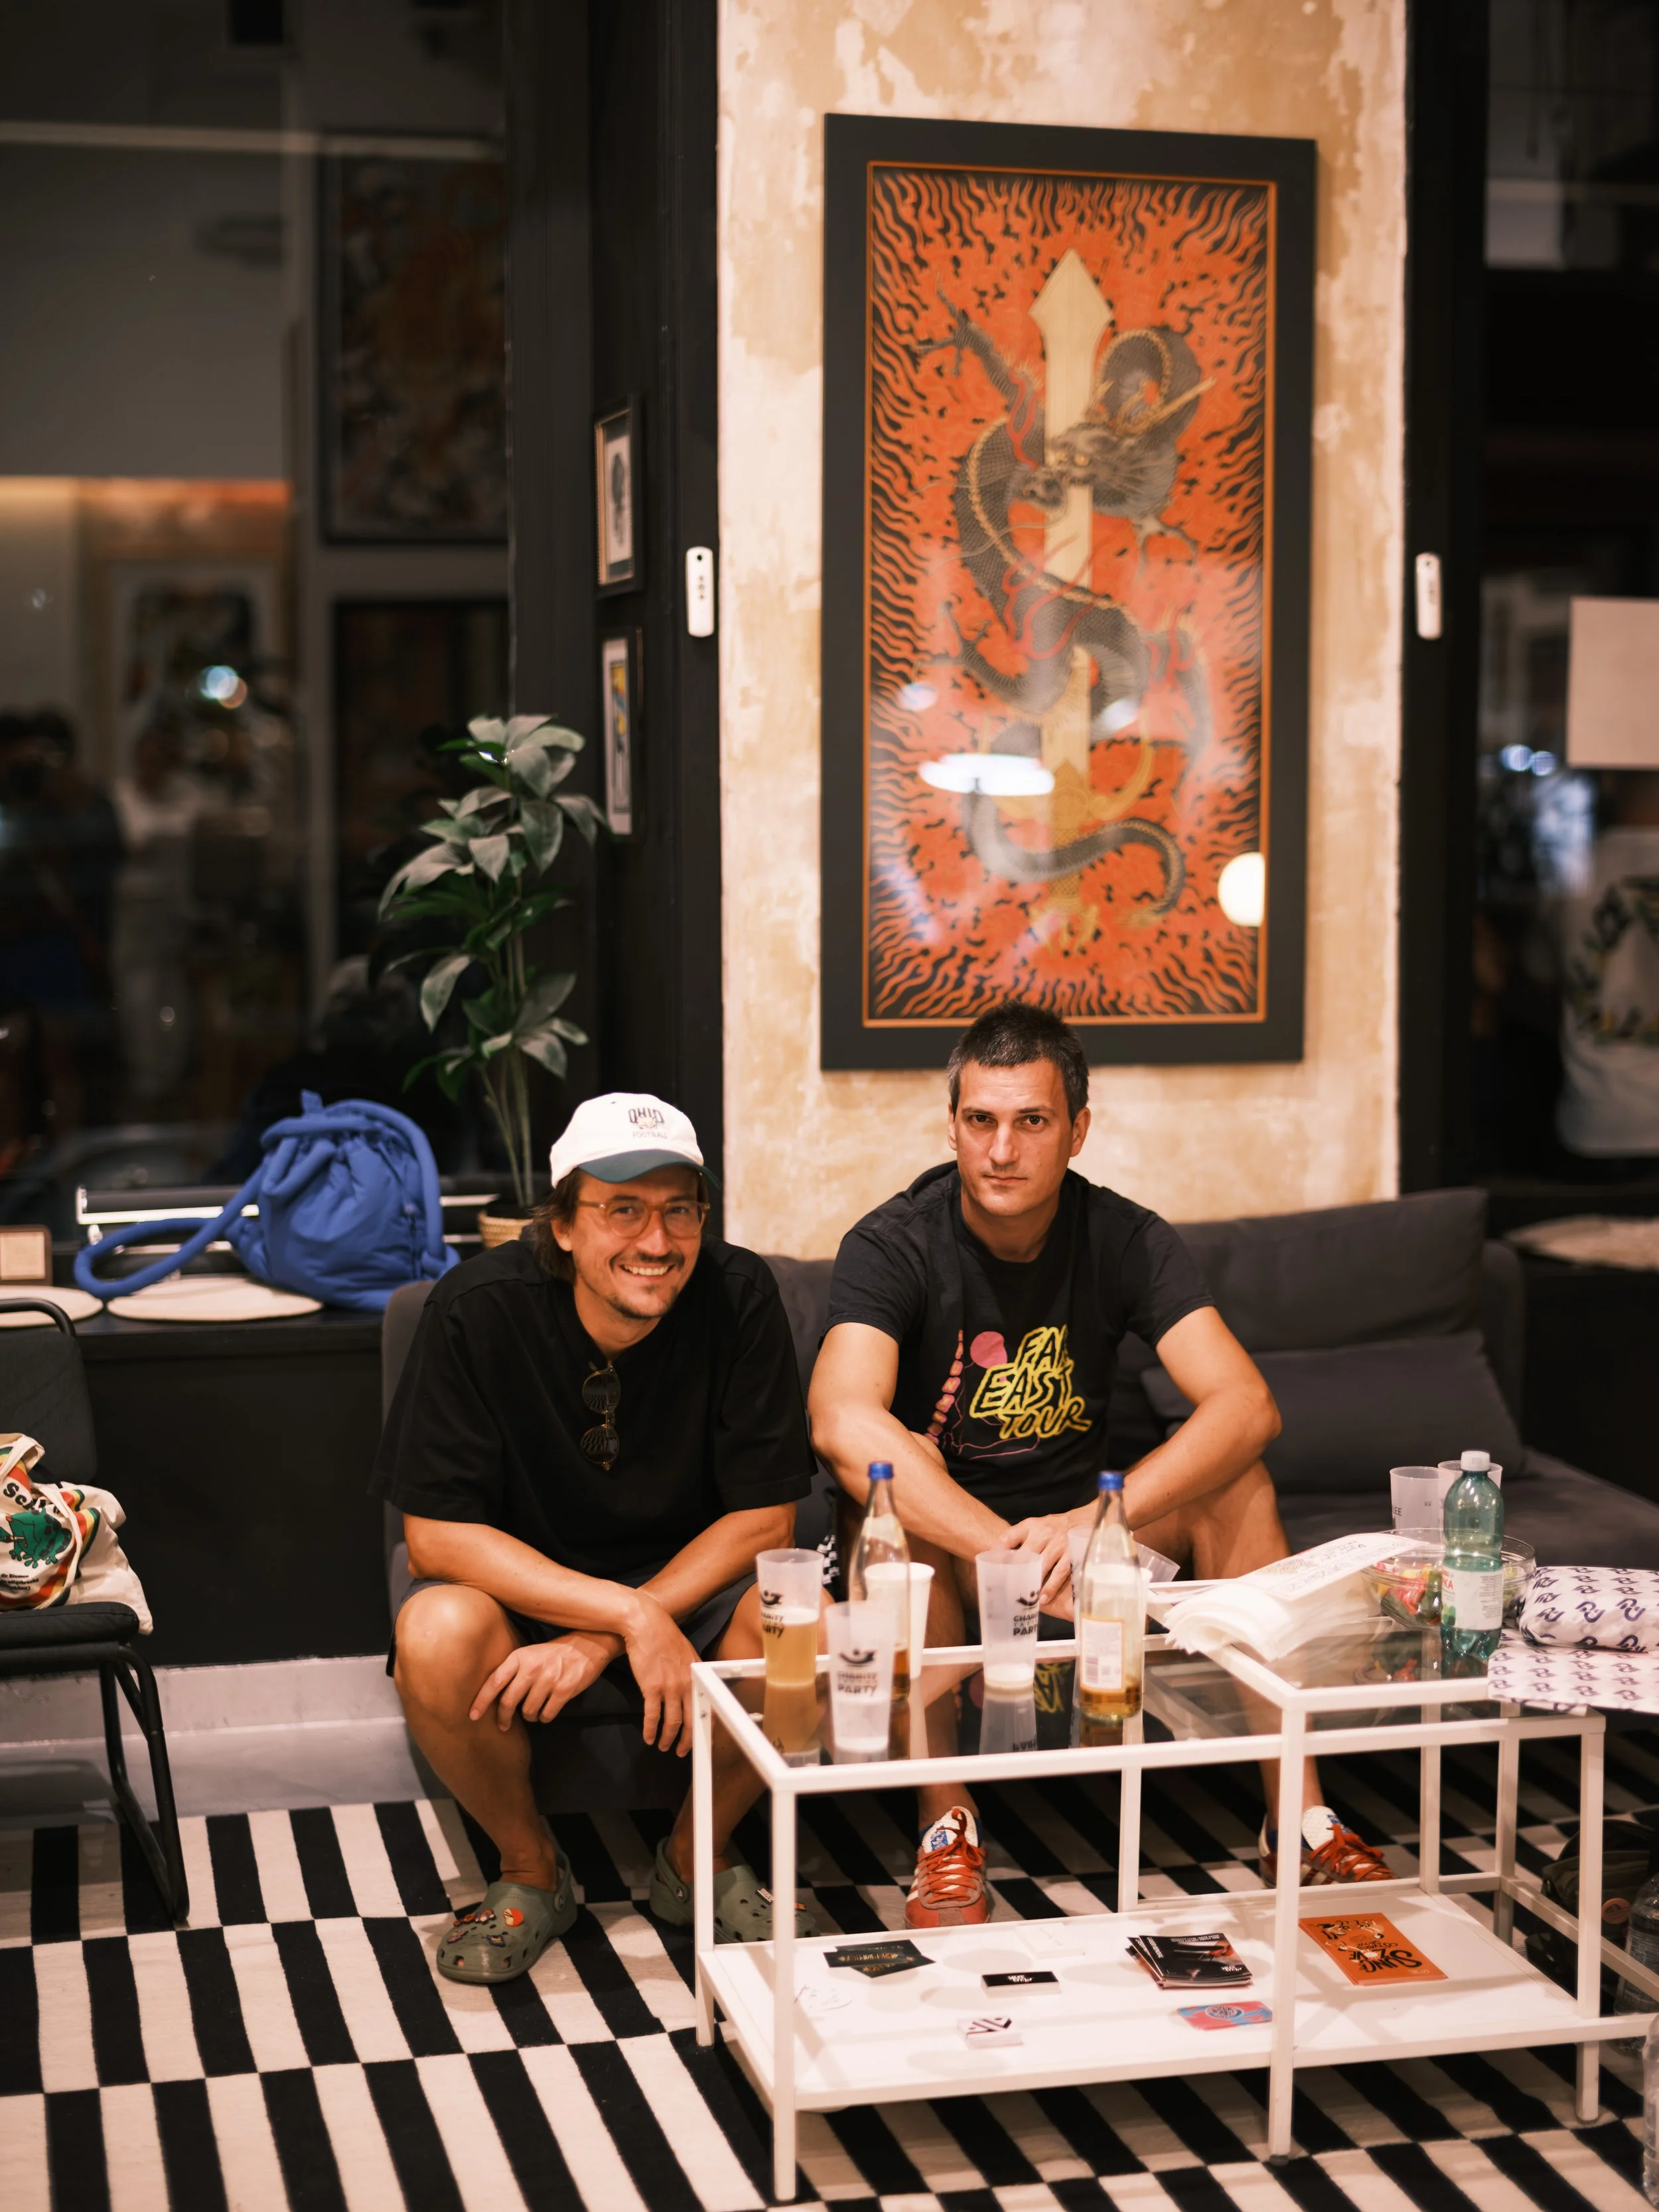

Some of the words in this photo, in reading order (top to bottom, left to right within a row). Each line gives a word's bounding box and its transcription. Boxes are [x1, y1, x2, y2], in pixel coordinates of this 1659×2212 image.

[628, 1107, 665, 1124] OHIO
[632, 1131, 668, 1140] FOOTBALL
[970, 1359, 1074, 1418] EAST
[997, 1396, 1093, 1439] TOUR
[1013, 1623, 1038, 1636] PART
[837, 1683, 878, 1697] PARTY
